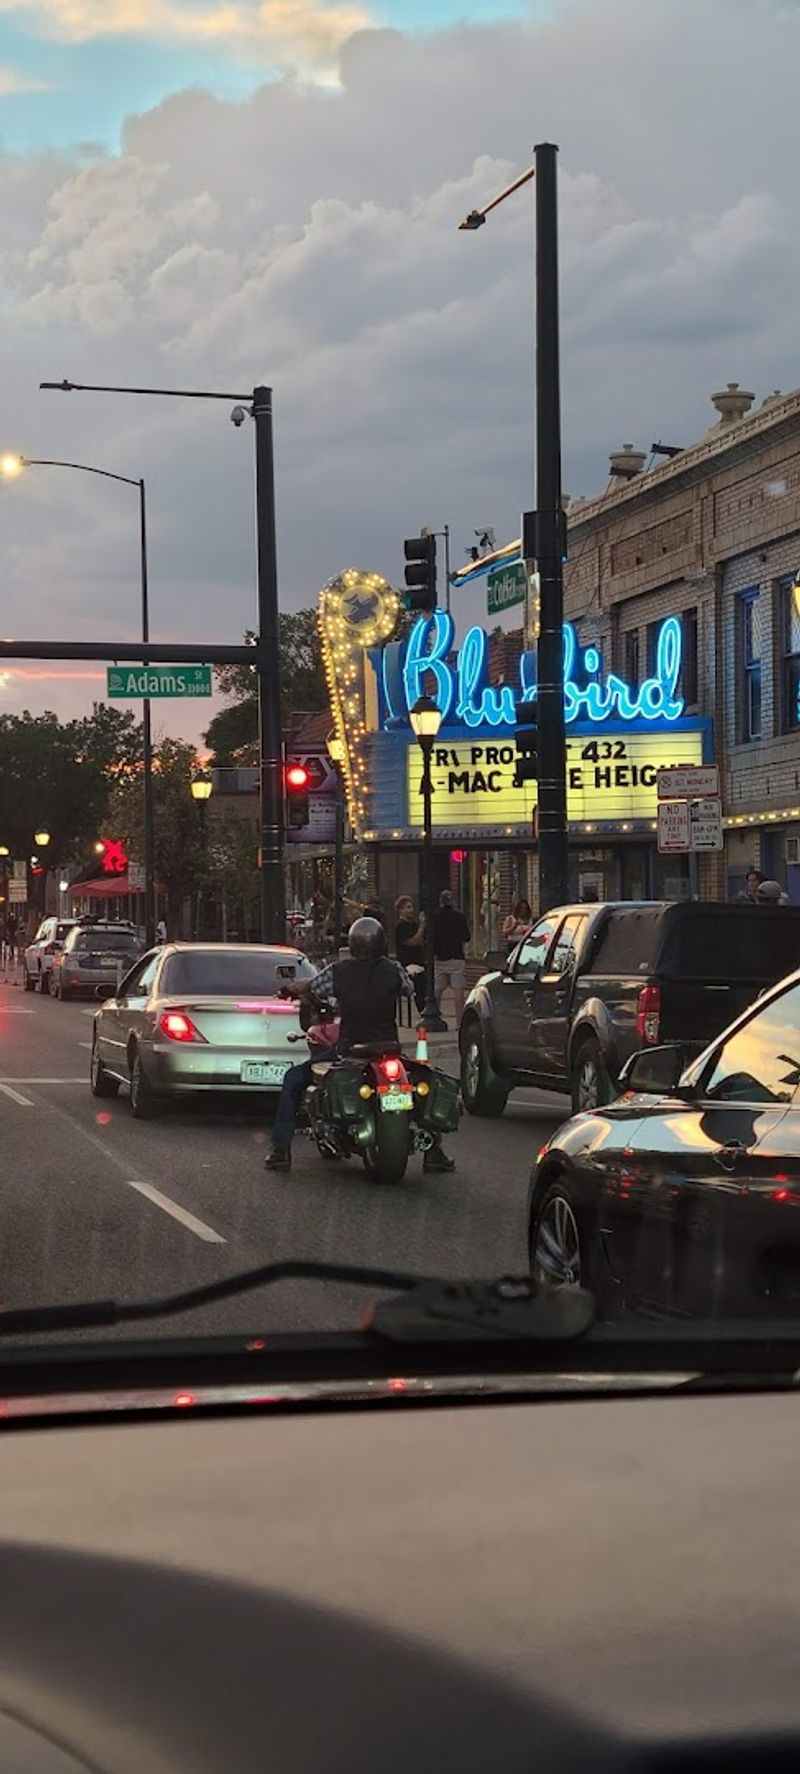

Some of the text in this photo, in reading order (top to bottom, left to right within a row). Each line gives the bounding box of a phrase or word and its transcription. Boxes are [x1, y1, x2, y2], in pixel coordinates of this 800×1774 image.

[126, 671, 186, 693] Adams
[581, 741, 627, 763] 432
[667, 804, 680, 814] NO
